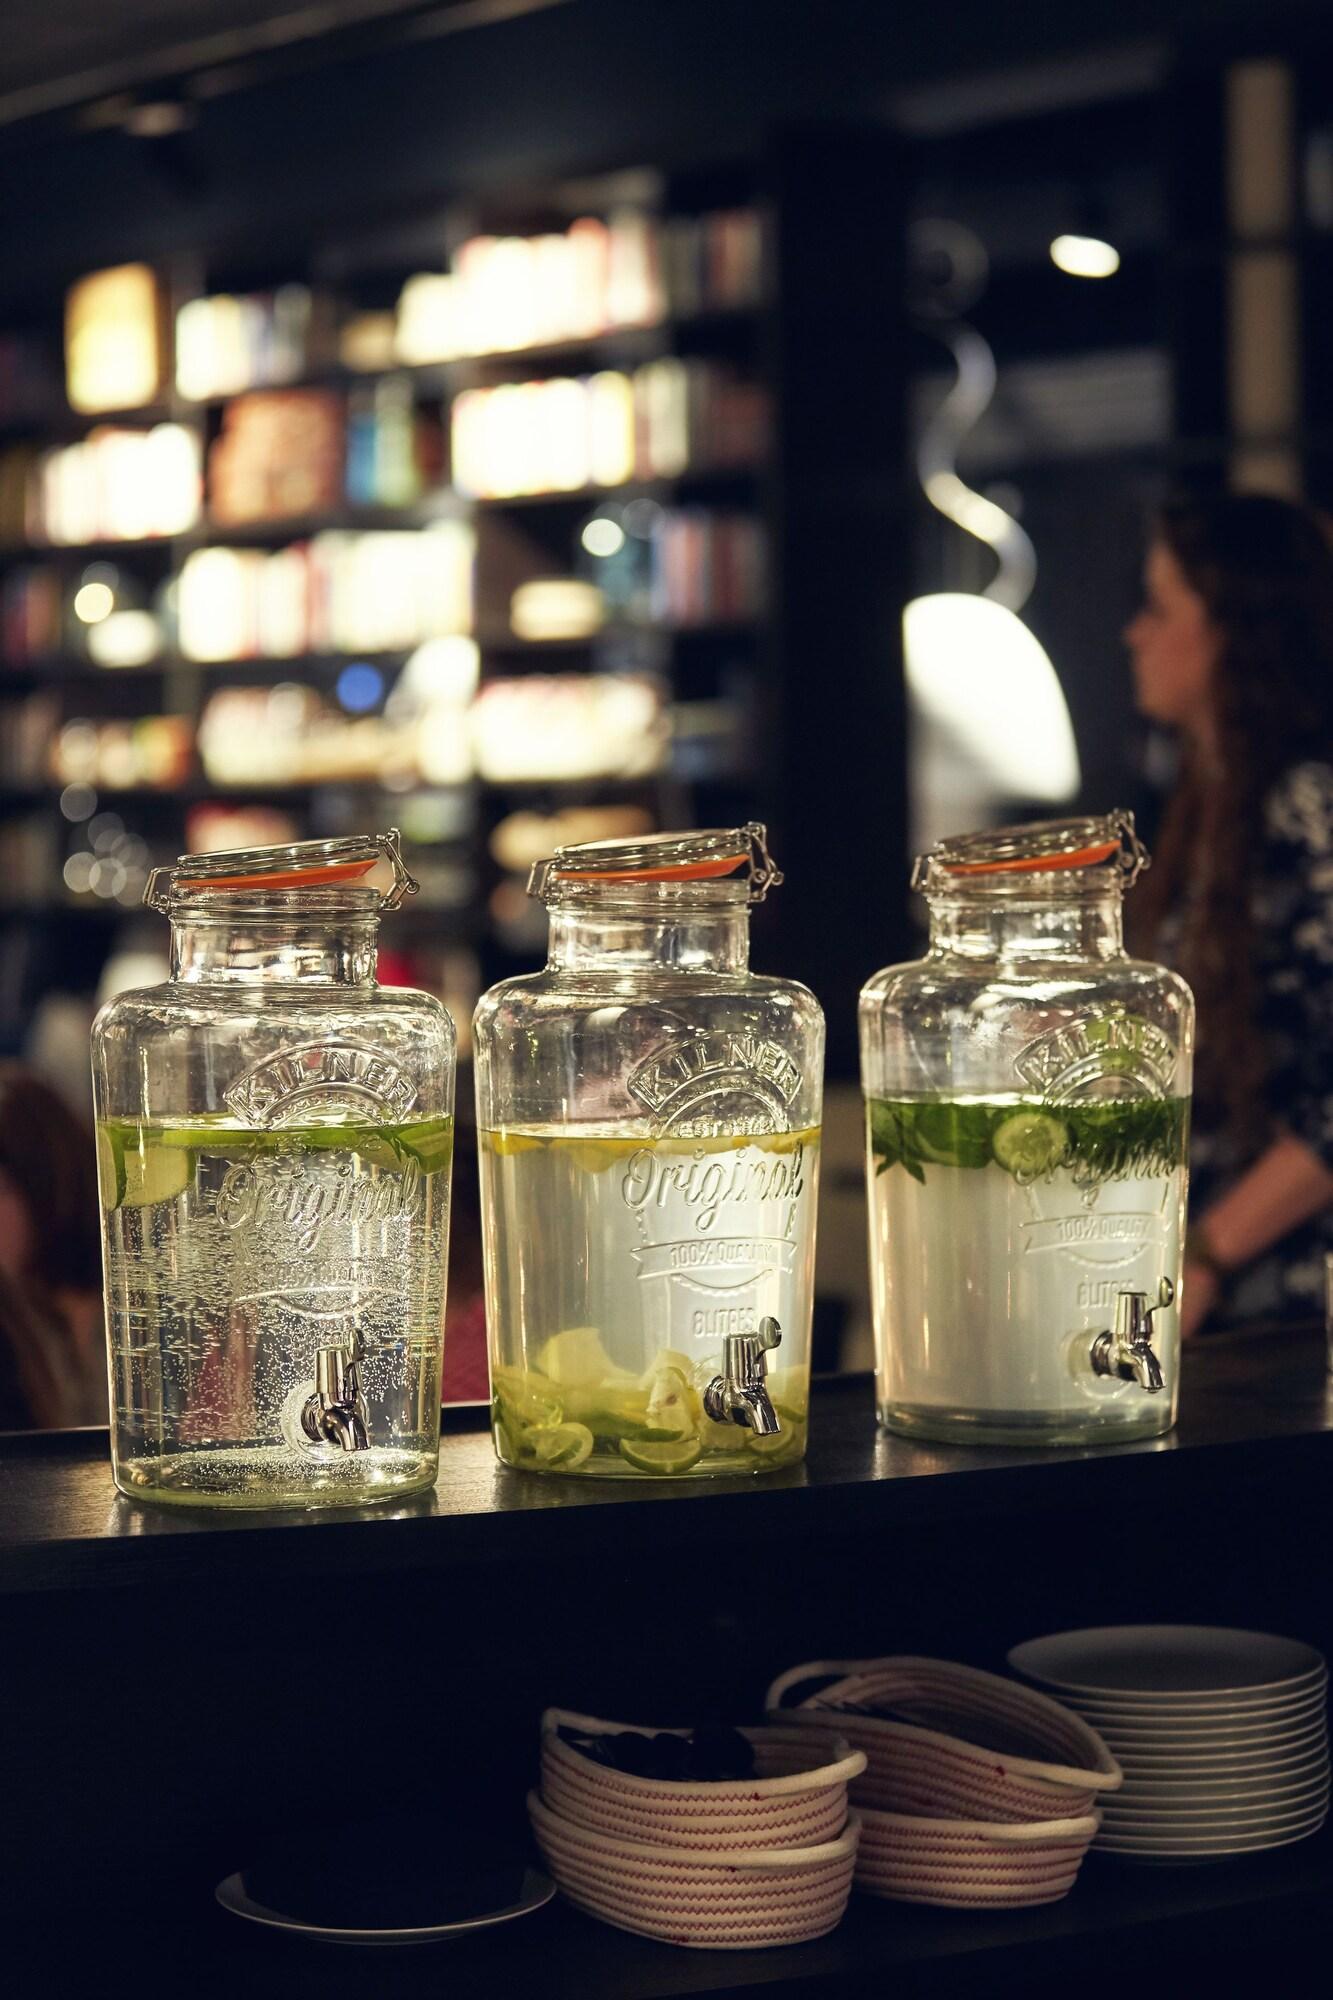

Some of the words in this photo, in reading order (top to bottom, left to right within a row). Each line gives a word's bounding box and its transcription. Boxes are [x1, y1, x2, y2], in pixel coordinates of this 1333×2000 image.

[232, 1049, 412, 1121] KILNER
[635, 1034, 798, 1104] KILNER
[216, 1156, 420, 1254] Original
[622, 1139, 804, 1234] Original
[670, 1241, 716, 1269] 100%
[718, 1241, 773, 1266] QUALITY
[1057, 1219, 1098, 1241] 100%
